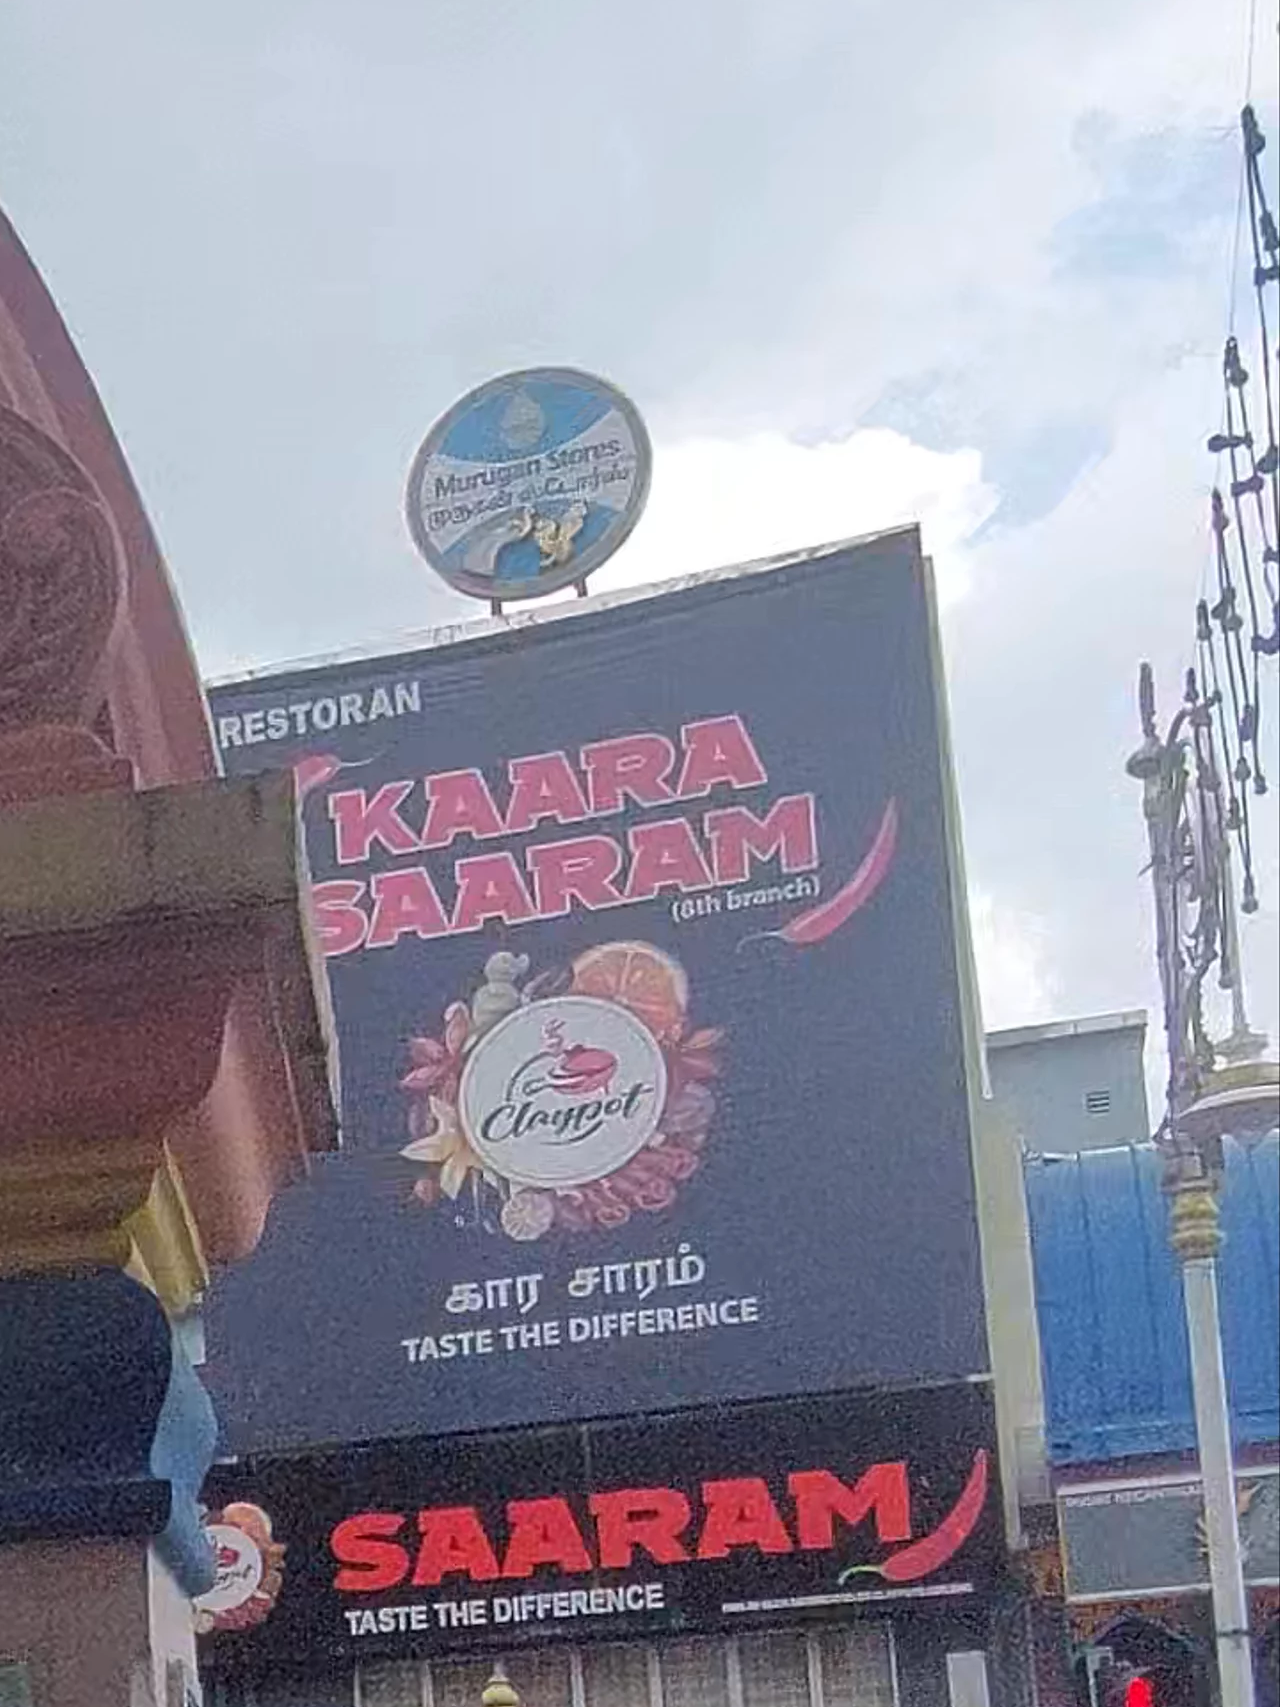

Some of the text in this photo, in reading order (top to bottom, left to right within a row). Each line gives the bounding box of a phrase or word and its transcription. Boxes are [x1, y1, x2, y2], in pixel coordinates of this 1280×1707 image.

[433, 439, 623, 499] Murugan Stores
[218, 681, 422, 749] RESTORAN
[330, 715, 768, 864] KAARA
[308, 793, 818, 957] SAARAM
[726, 876, 821, 911] branch)
[481, 1084, 655, 1145] Claypot
[444, 1242, 706, 1314] கார சாரம்
[401, 1298, 761, 1363] TASTE THE DIFFERENCE
[330, 1463, 912, 1591] SAARAM
[345, 1582, 665, 1636] TASTE THE DIFFERENCE
